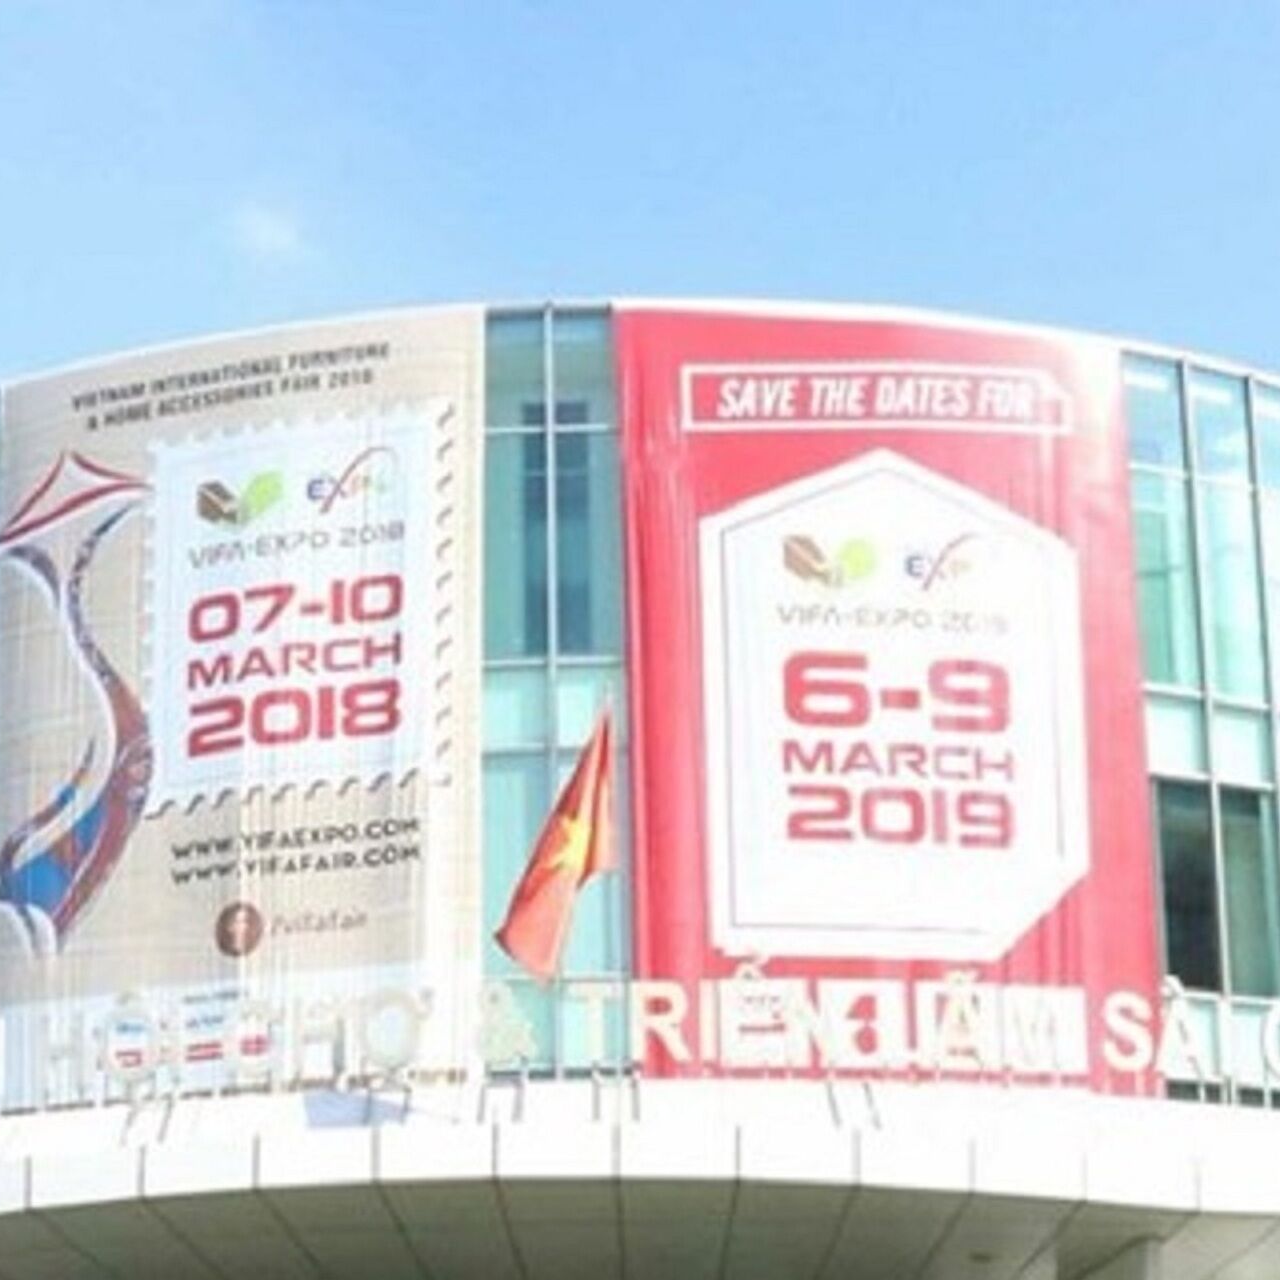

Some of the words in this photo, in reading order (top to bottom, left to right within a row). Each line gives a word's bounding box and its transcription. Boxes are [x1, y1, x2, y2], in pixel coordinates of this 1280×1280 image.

[72, 382, 146, 411] VIETNAM
[149, 355, 282, 394] INTERNATIONAL
[288, 341, 390, 370] FURNITURE
[103, 401, 150, 426] HOME
[158, 379, 274, 416] ACCESSORIES
[281, 371, 320, 393] FAIR
[328, 366, 374, 389] 2018
[716, 375, 800, 419] SAVE
[808, 374, 869, 418] THE
[874, 374, 972, 419] DATES
[977, 378, 1035, 420] FOR
[338, 520, 405, 549] 2018
[187, 573, 404, 644] 07-10
[186, 632, 403, 691] MARCH
[781, 650, 1013, 733] 6-9
[185, 677, 403, 759] 2018
[782, 740, 1015, 781] MARCH
[786, 784, 1015, 849] 2019
[1102, 975, 1231, 1083] SÀI
